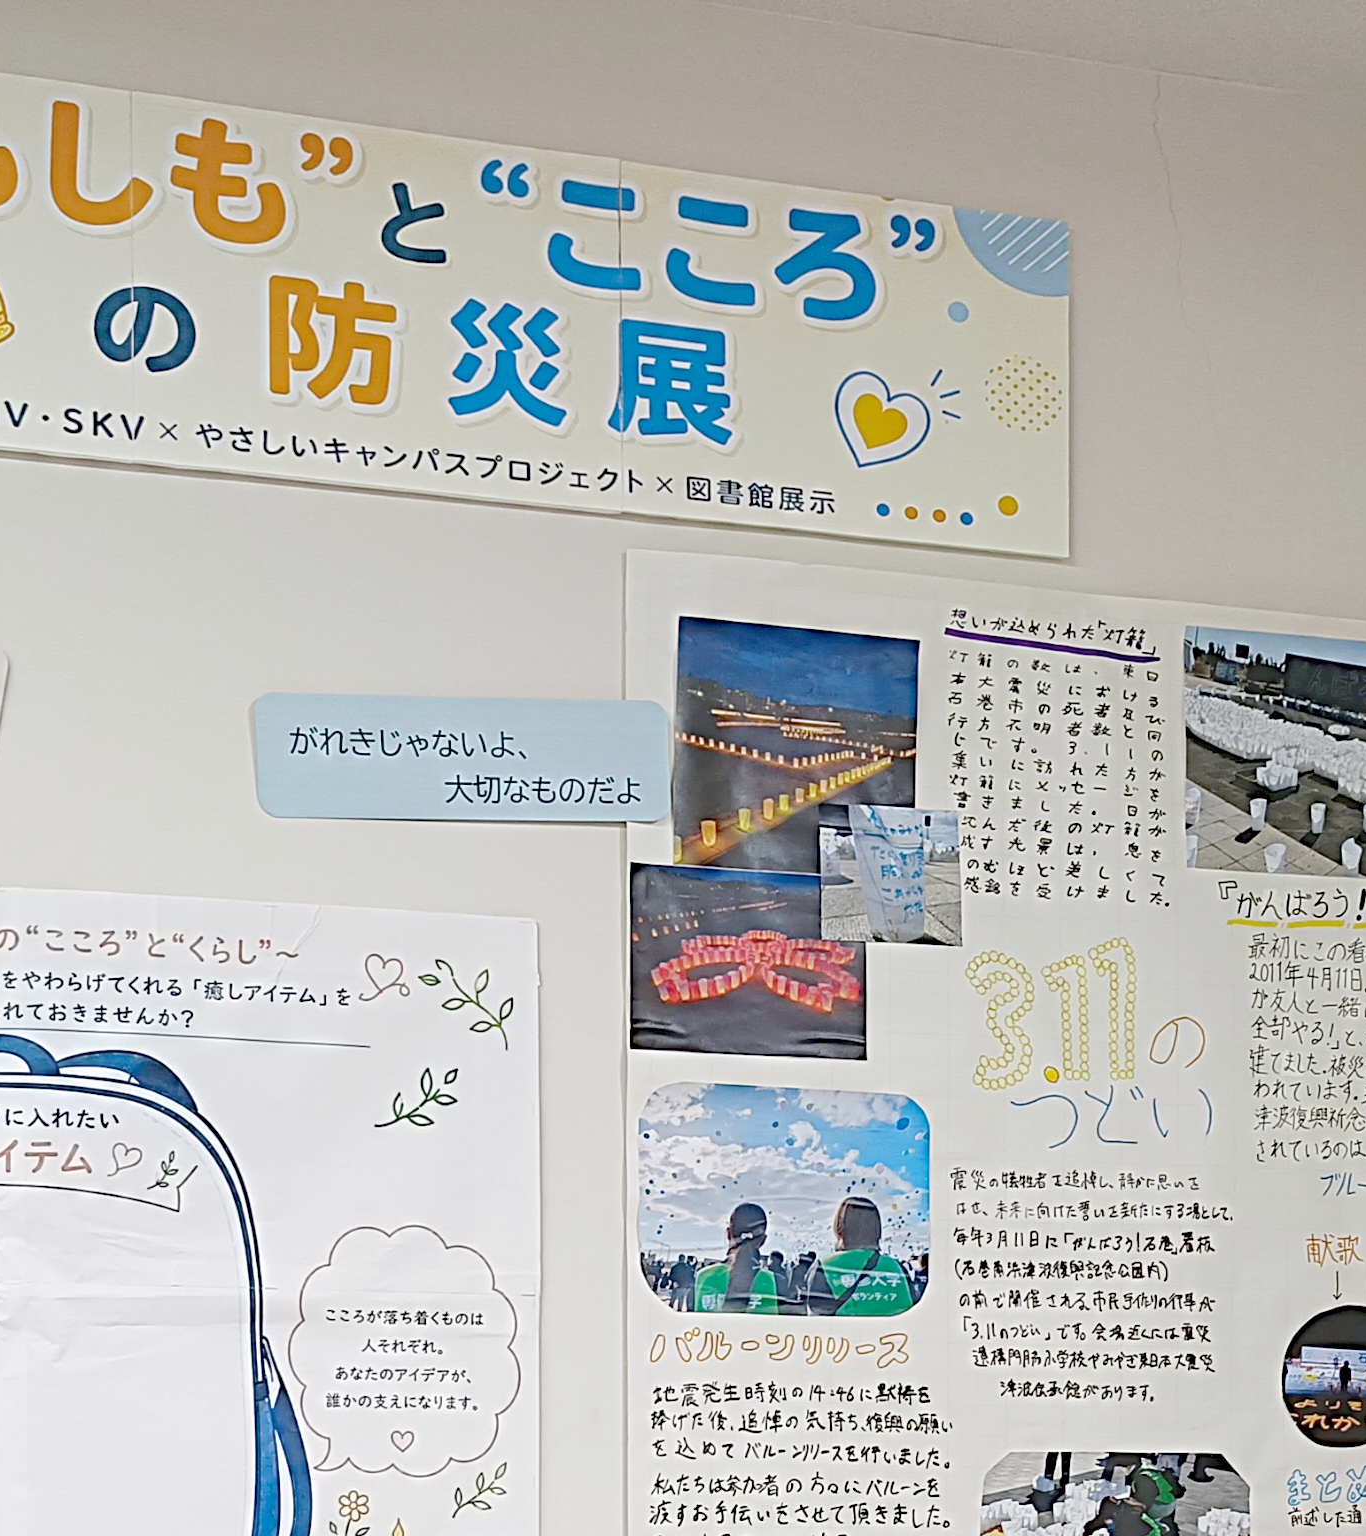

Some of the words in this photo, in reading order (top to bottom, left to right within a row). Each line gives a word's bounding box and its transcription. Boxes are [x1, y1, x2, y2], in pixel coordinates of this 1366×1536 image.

[94, 275, 735, 448] の防災展
[289, 725, 528, 760] がれきじゃないよ、
[444, 774, 640, 806] 大切なものだよ
[1010, 1085, 1212, 1149] つどい
[1306, 1233, 1364, 1267] 献歌
[325, 1309, 484, 1326] こころが落ち着くものは
[362, 1338, 445, 1355] 人それぞれ。
[650, 1328, 909, 1368] バルーンリリース
[335, 1366, 473, 1384] あなたのアイデアが、
[326, 1394, 480, 1411] 誰かの支えになります。
[649, 1502, 951, 1529] 渡すお手伝いをさせて頂きました。
